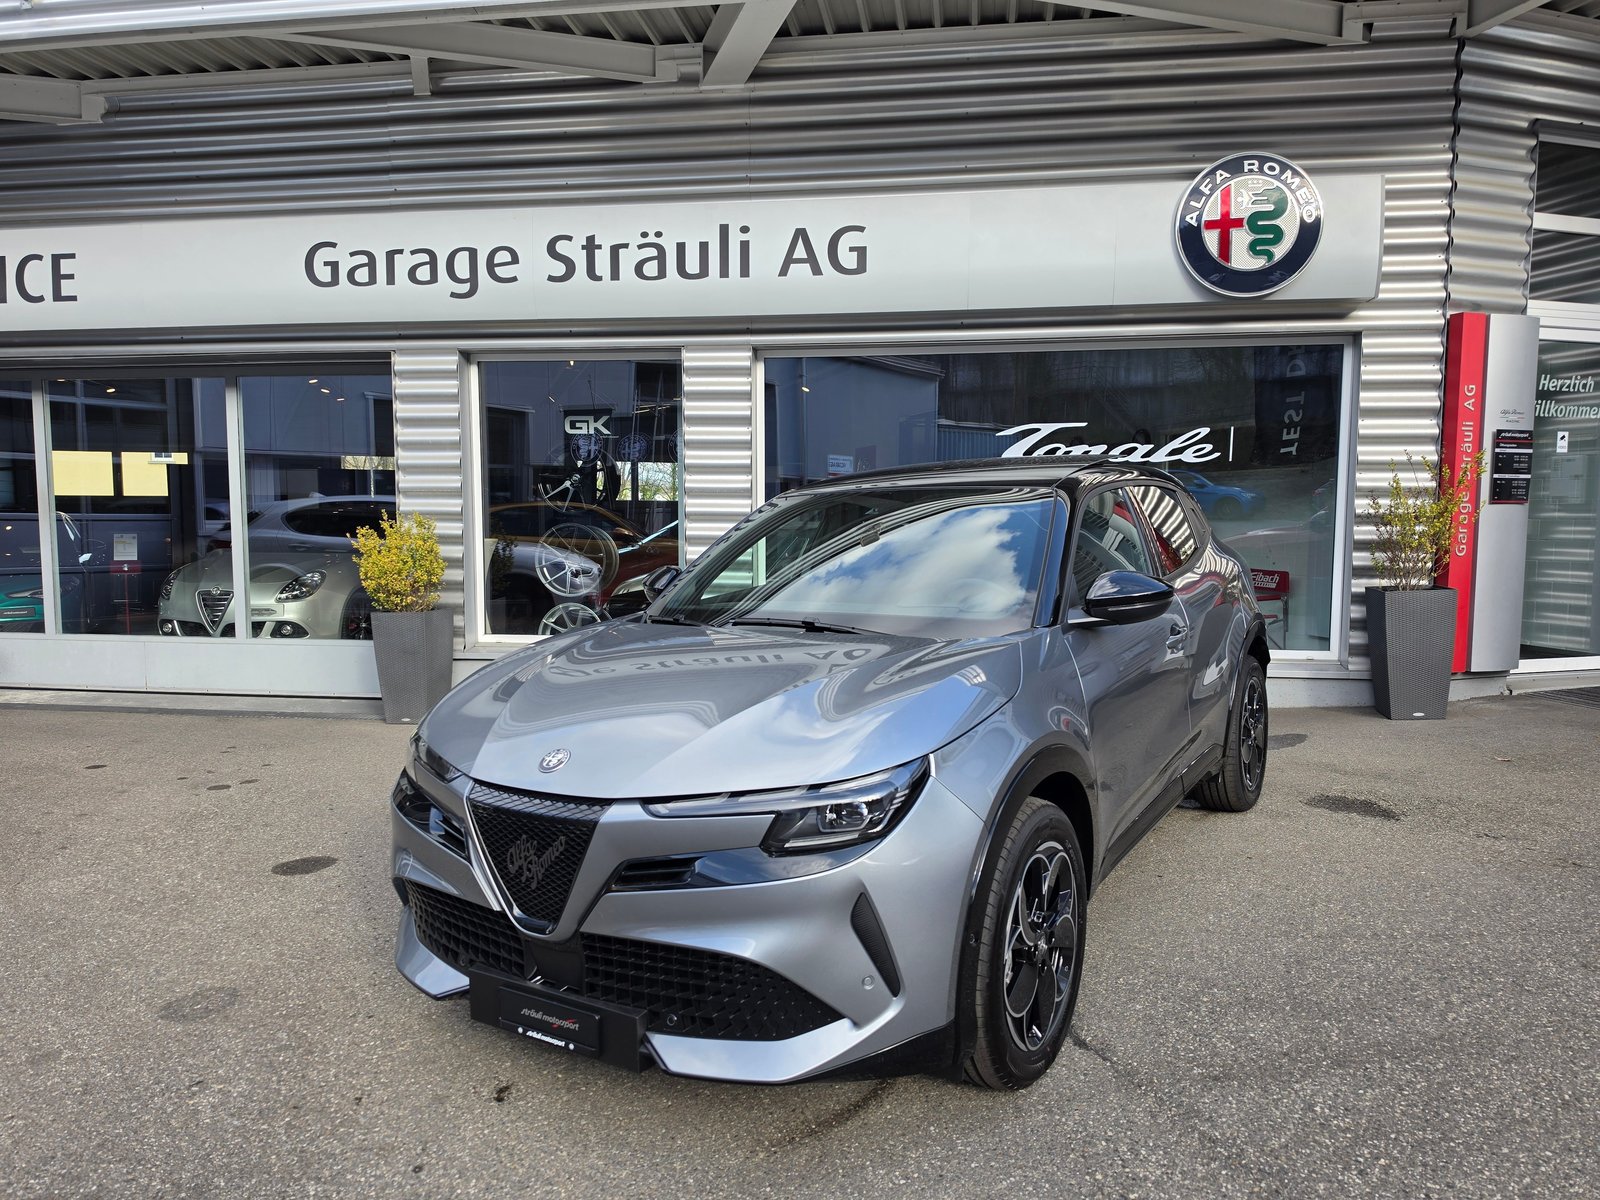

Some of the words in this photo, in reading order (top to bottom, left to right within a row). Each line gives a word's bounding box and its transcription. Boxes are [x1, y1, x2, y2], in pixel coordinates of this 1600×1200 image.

[1185, 169, 1231, 227] ALFA
[1243, 159, 1318, 223] ROMEO
[304, 240, 520, 299] Garage
[546, 223, 751, 283] Sträuli
[777, 224, 868, 278] AG
[1539, 374, 1595, 393] Herzlich
[564, 415, 612, 435] GK
[1534, 399, 1600, 419] illkomme
[996, 422, 1221, 463] Tonale
[1455, 490, 1473, 557] Garage
[1464, 384, 1476, 411] AG
